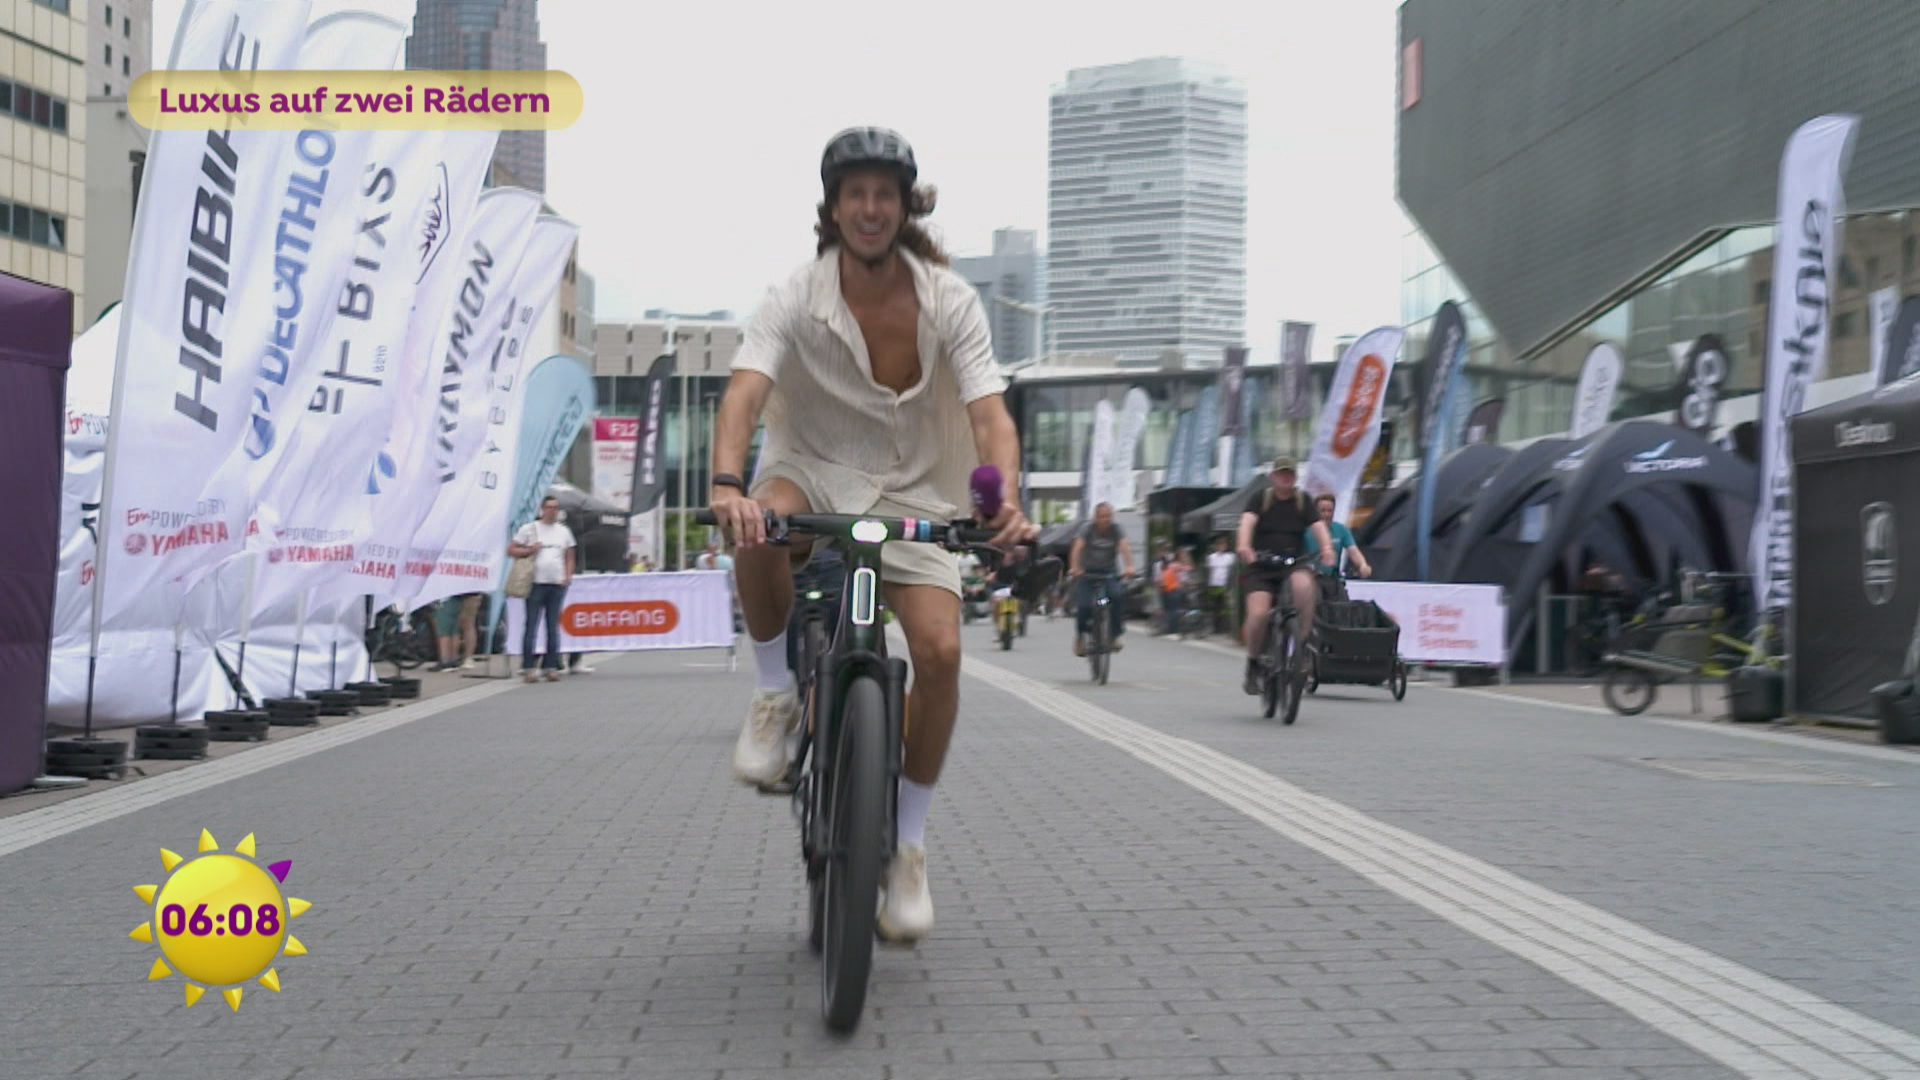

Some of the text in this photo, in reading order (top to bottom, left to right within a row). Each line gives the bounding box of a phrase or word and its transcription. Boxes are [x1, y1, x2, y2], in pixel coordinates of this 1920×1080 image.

[151, 520, 229, 557] YAMAHA
[286, 542, 354, 563] YAMAHA
[438, 562, 489, 580] YAMAHA
[572, 608, 667, 629] BAFANG
